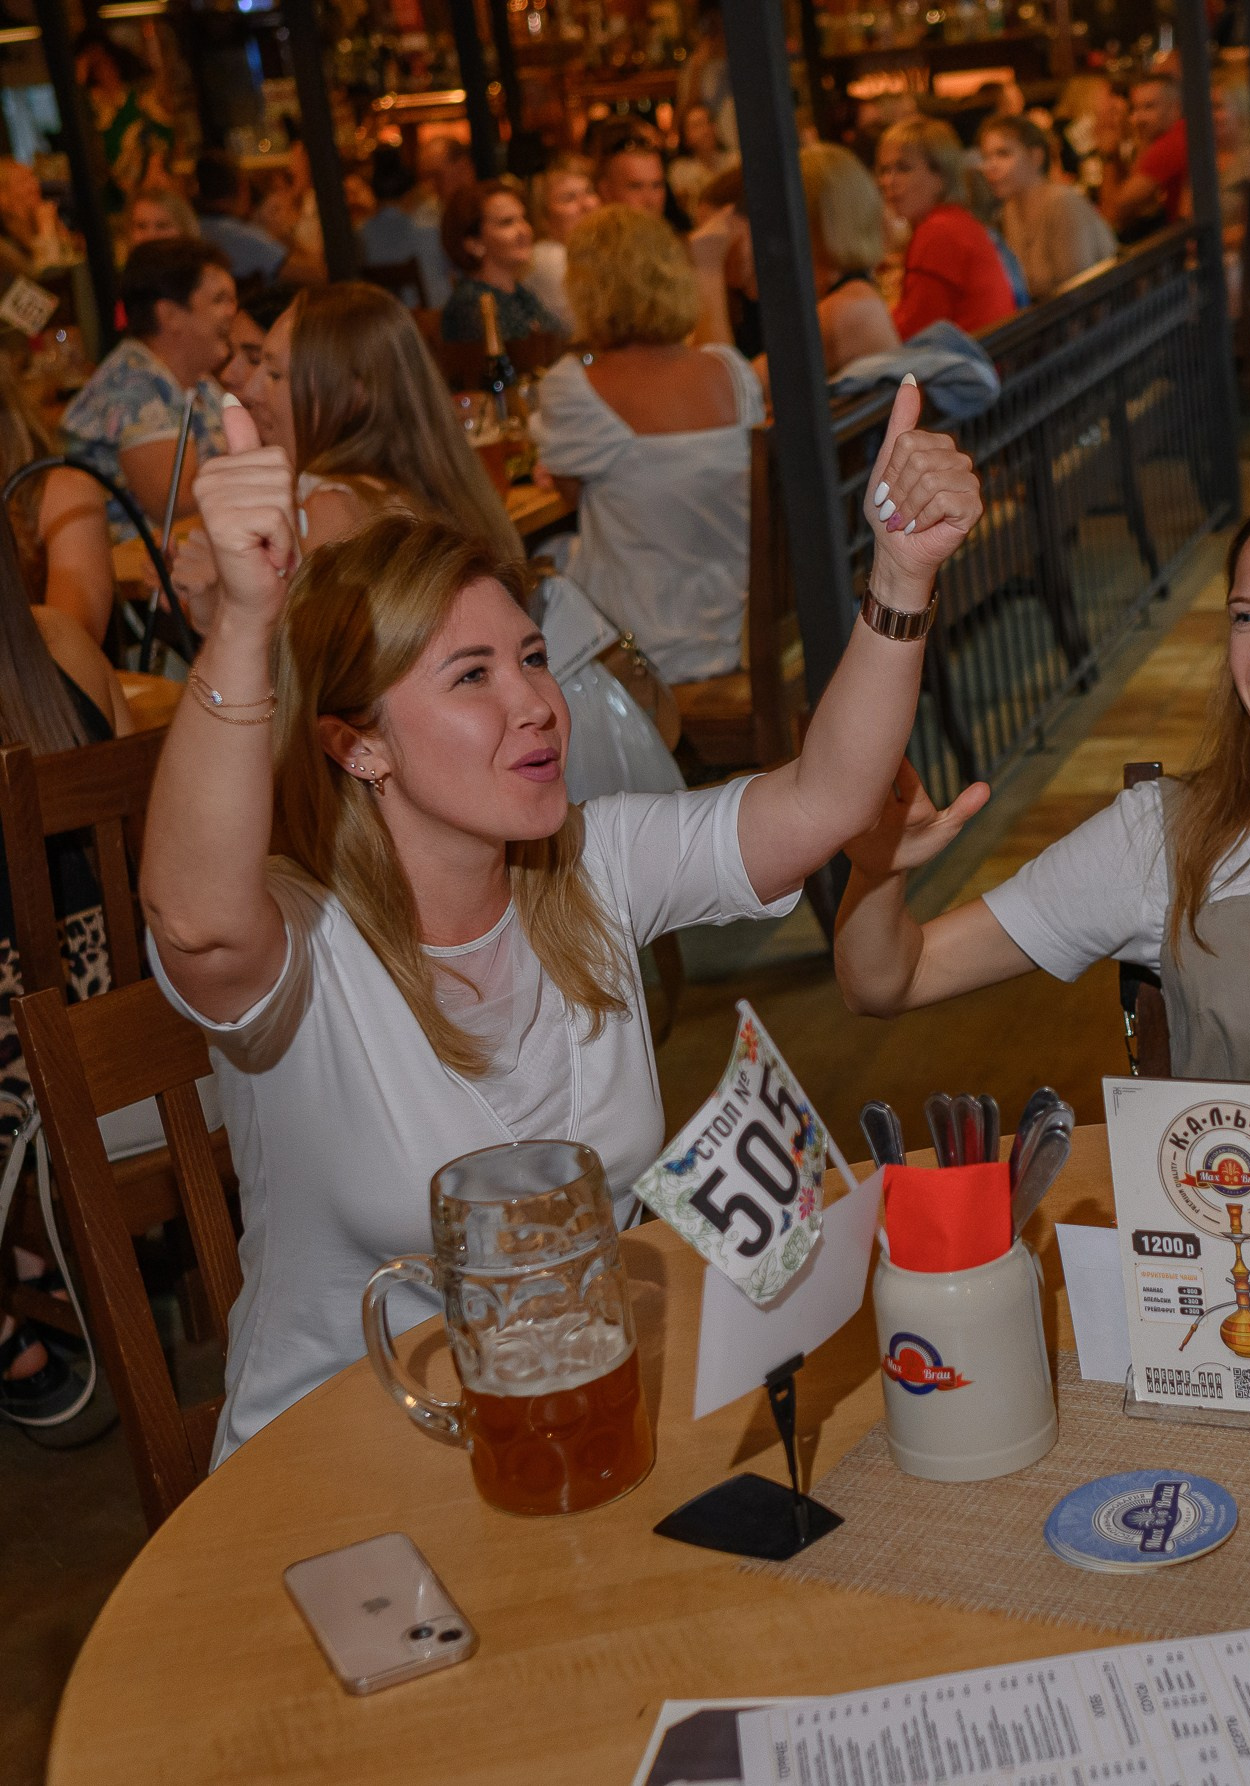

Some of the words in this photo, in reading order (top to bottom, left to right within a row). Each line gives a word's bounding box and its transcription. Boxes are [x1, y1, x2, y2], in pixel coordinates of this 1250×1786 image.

[695, 1103, 743, 1160] СТОЛ
[736, 1070, 753, 1106] №
[689, 1064, 806, 1258] 505
[1199, 1171, 1220, 1182] Max
[1179, 1189, 1200, 1214] PREMIUM
[1141, 1235, 1184, 1254] 1200
[1140, 1271, 1178, 1280] ФРУКТОВЫЕ
[1143, 1296, 1171, 1304] АПЕЛЬСИН
[1144, 1306, 1175, 1314] ГРЕЙПФРУТ
[887, 1358, 903, 1374] Max
[1146, 1367, 1191, 1383] ЧАЕВЫЕ
[1198, 1371, 1222, 1385] ДЛЯ
[1147, 1380, 1224, 1399] КАЛЬЯНЩИКА
[1145, 1529, 1165, 1548] Max
